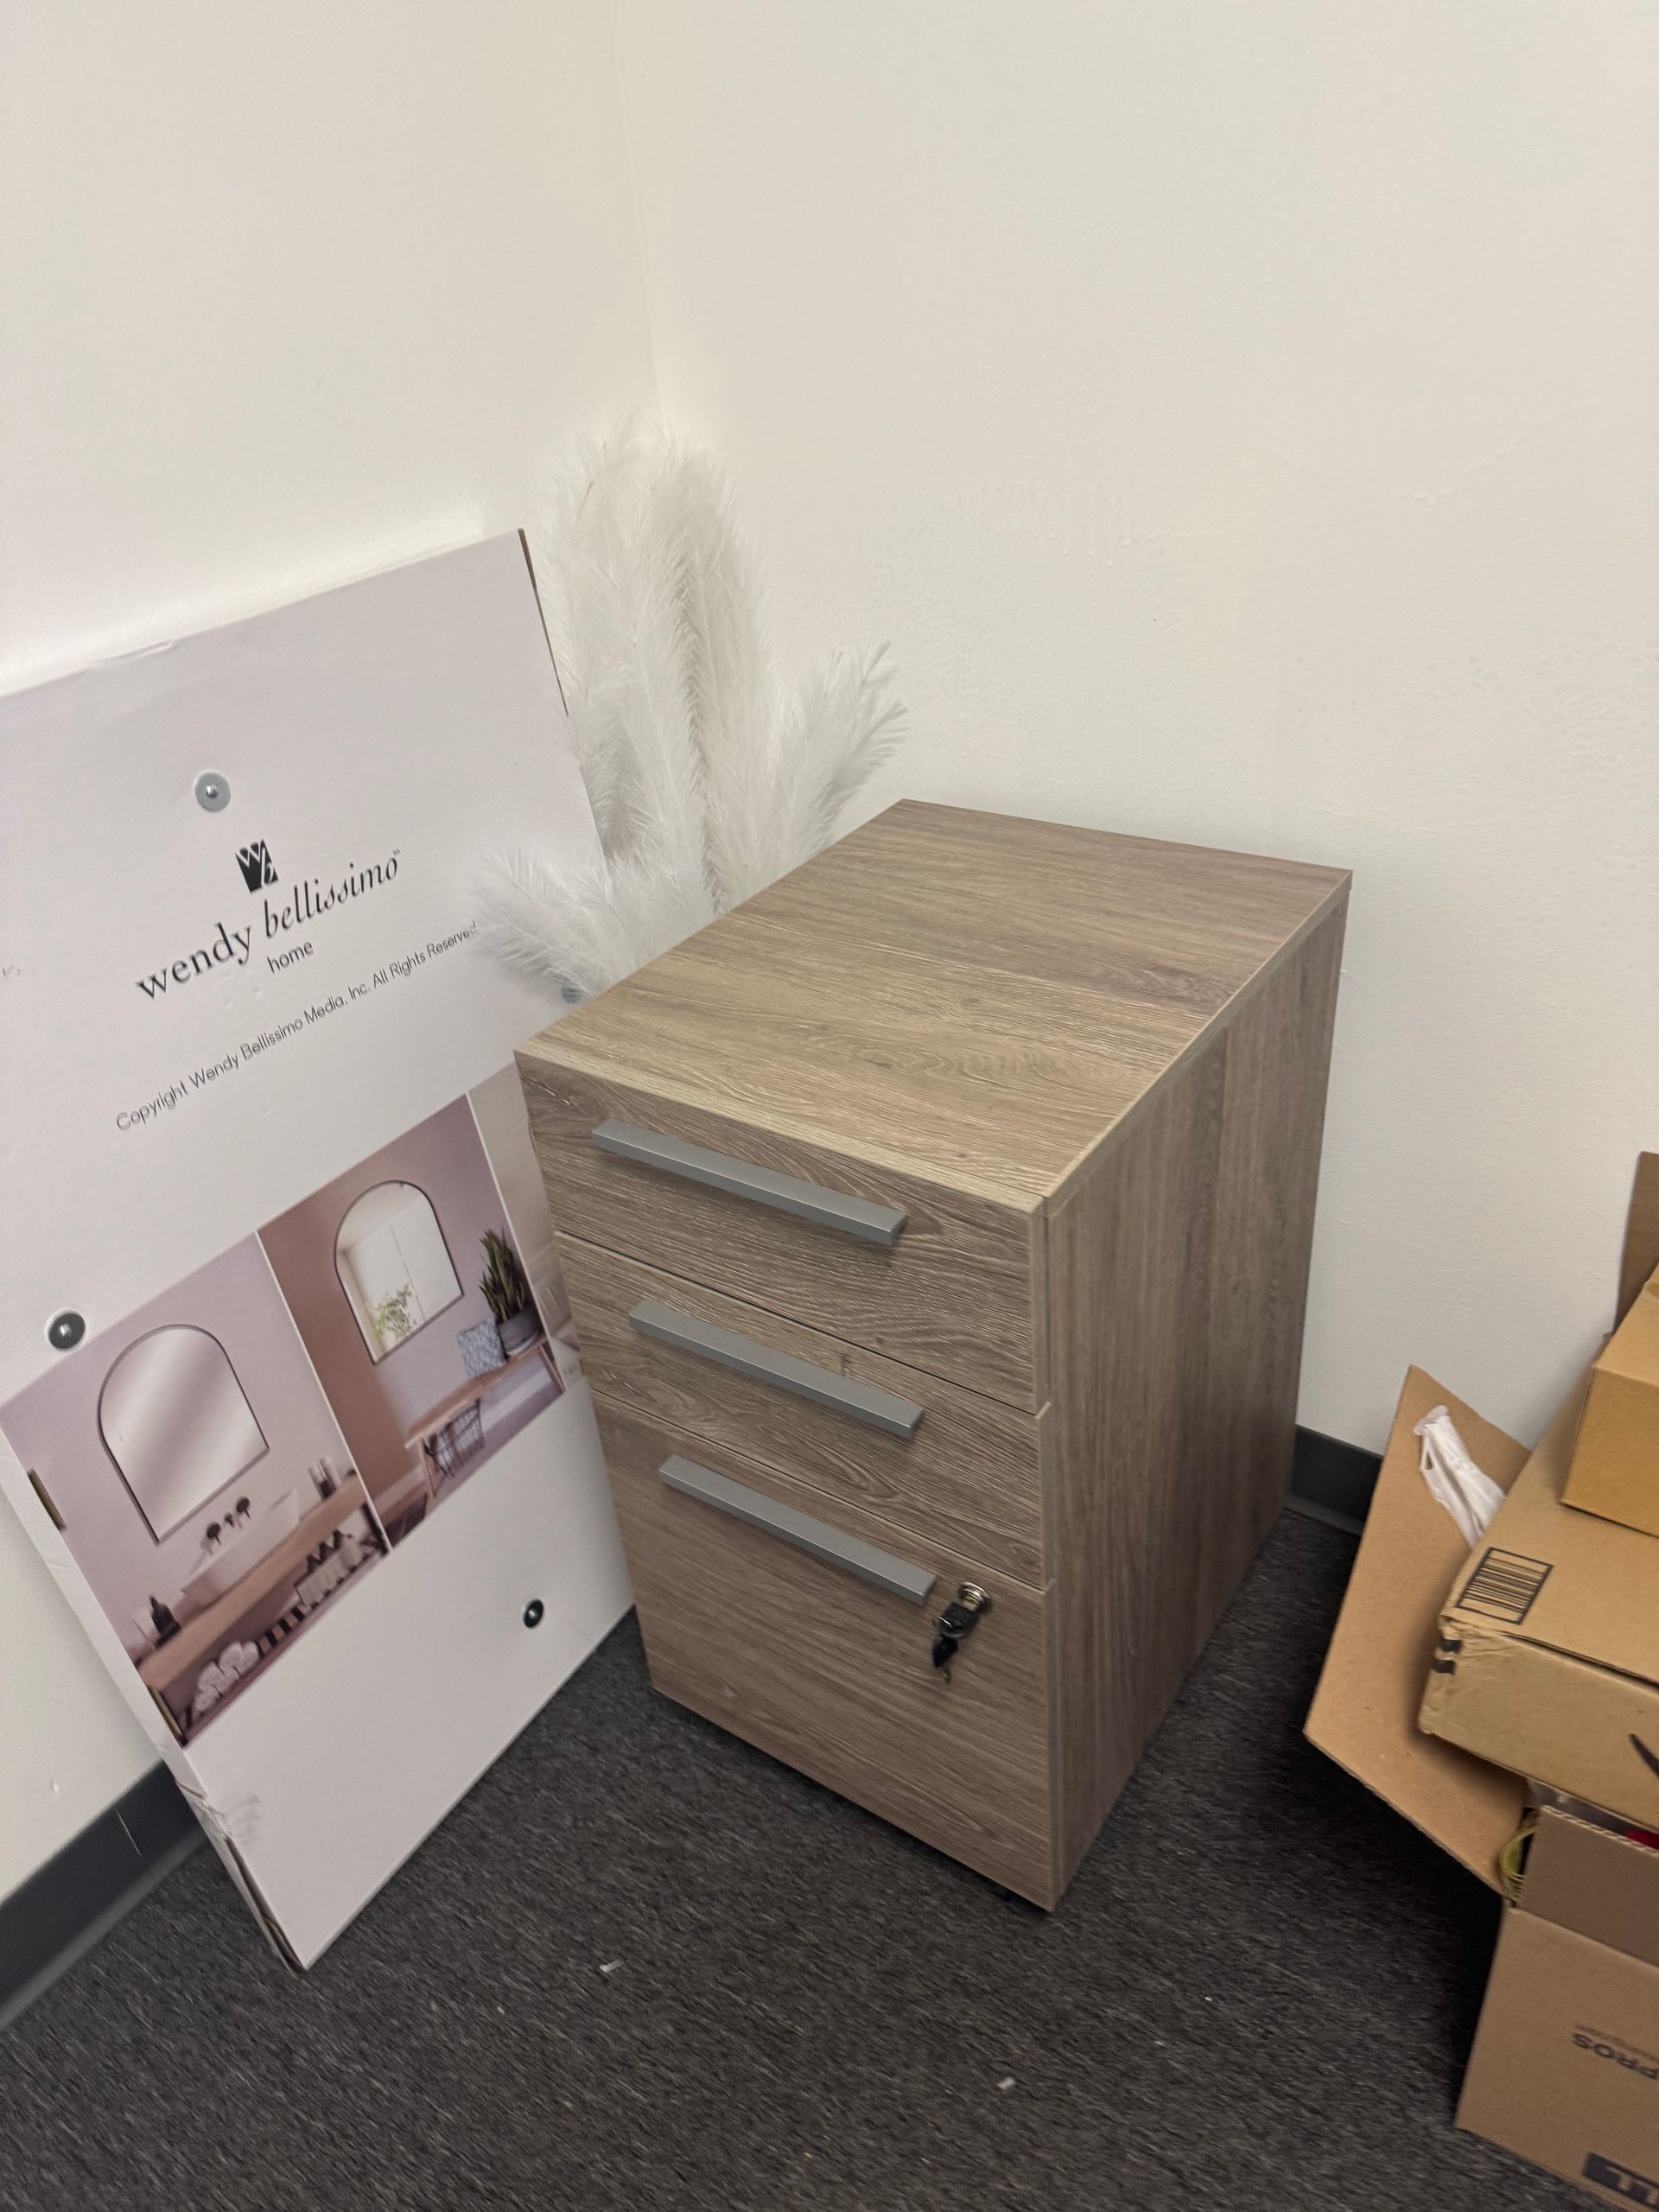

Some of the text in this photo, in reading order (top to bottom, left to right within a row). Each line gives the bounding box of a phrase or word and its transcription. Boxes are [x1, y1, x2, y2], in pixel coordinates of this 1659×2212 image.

[135, 921, 251, 1001] wendy
[266, 941, 315, 974] home
[117, 1080, 189, 1131] Copyright
[188, 1052, 240, 1090] Wendy
[240, 1019, 303, 1062] Bellissimo
[303, 995, 349, 1026] Media,
[348, 983, 371, 1001] Inc.
[372, 969, 389, 989] All
[389, 951, 427, 980] Rights
